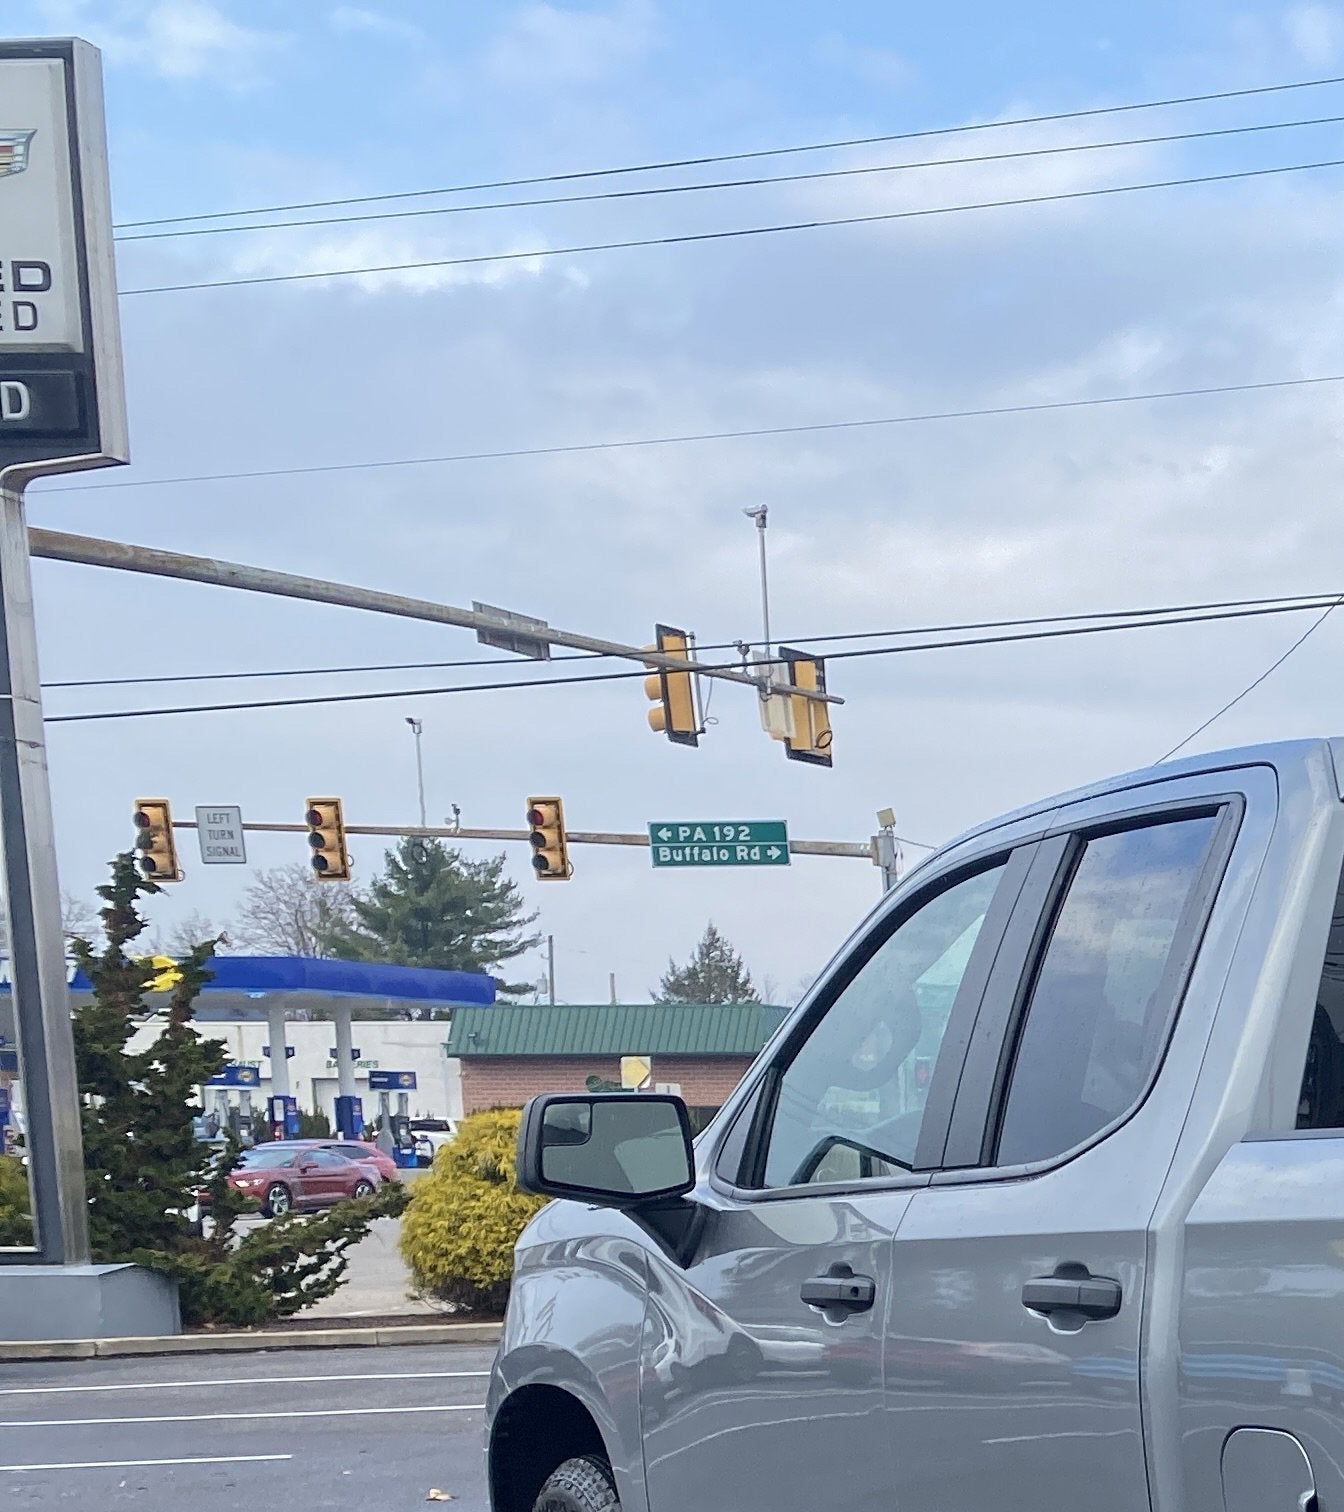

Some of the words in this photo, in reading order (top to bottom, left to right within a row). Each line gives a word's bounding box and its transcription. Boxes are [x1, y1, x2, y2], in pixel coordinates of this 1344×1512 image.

[207, 813, 230, 824] LEFT
[208, 830, 234, 840] TURN
[678, 826, 706, 842] PA
[713, 825, 751, 841] 192
[206, 846, 241, 857] SIGNAL
[658, 847, 729, 862] Buffalo
[736, 846, 760, 861] Rd
